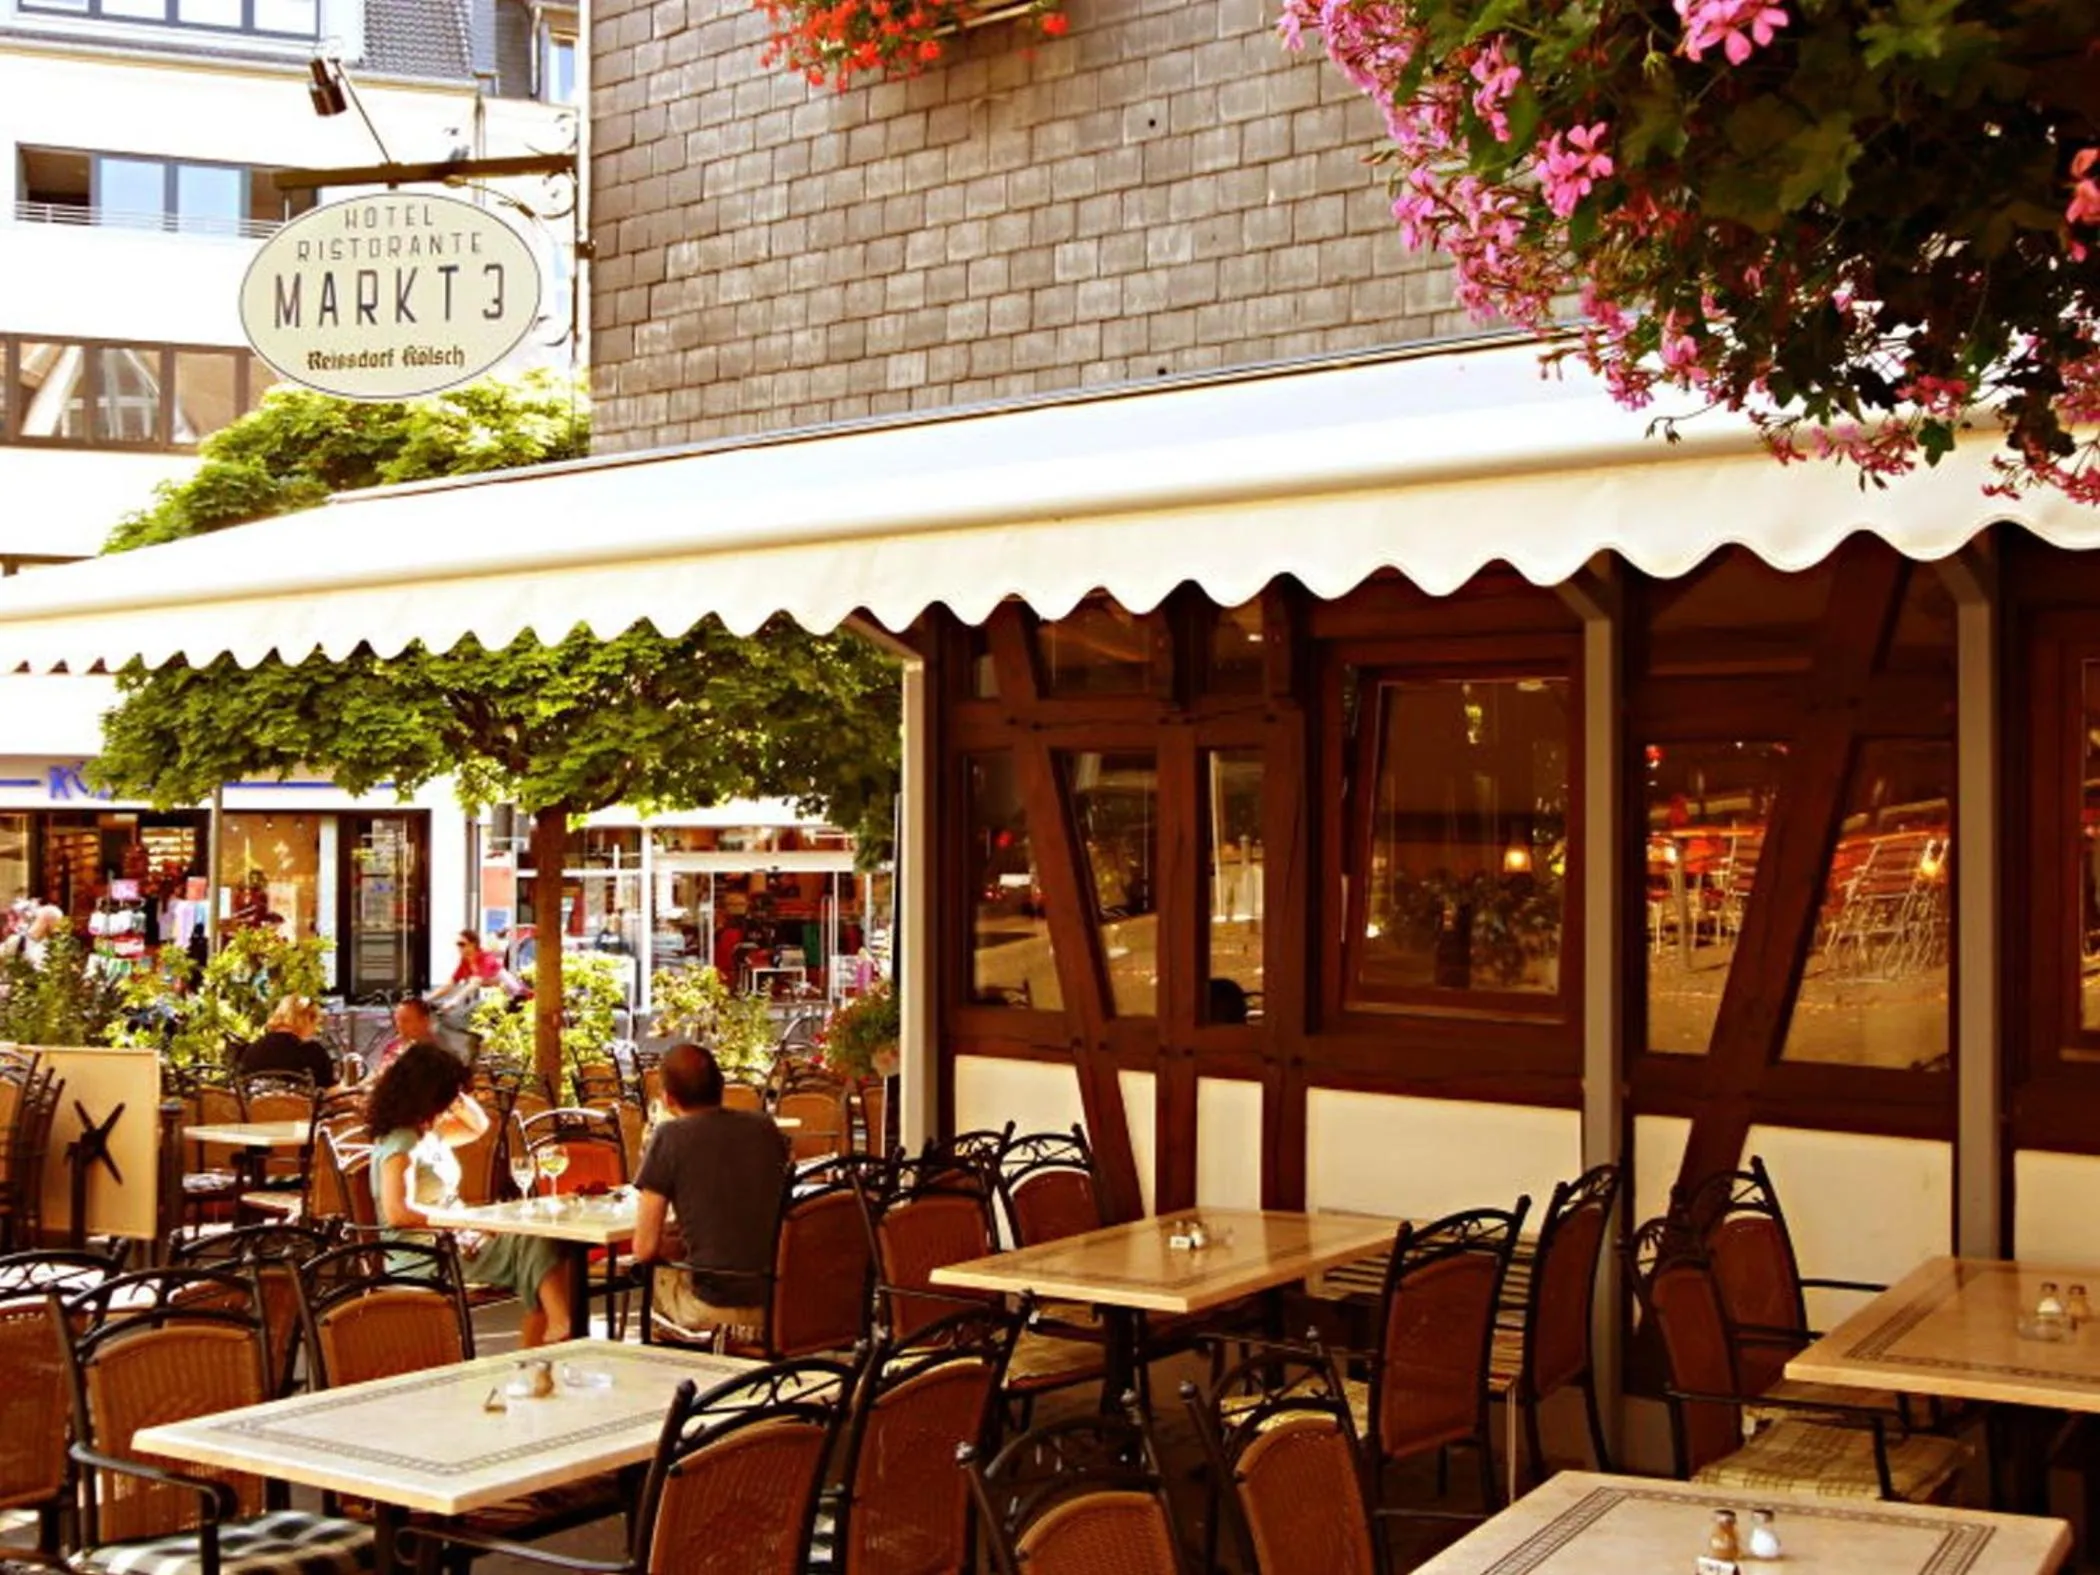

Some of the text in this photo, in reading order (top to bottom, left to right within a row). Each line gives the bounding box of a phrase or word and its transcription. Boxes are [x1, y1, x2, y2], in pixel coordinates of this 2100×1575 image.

[345, 204, 434, 230] HOTEL
[297, 232, 482, 262] RISTORANTE
[274, 263, 505, 329] MARKT 3
[307, 344, 465, 370] Reissdorf Kölsch
